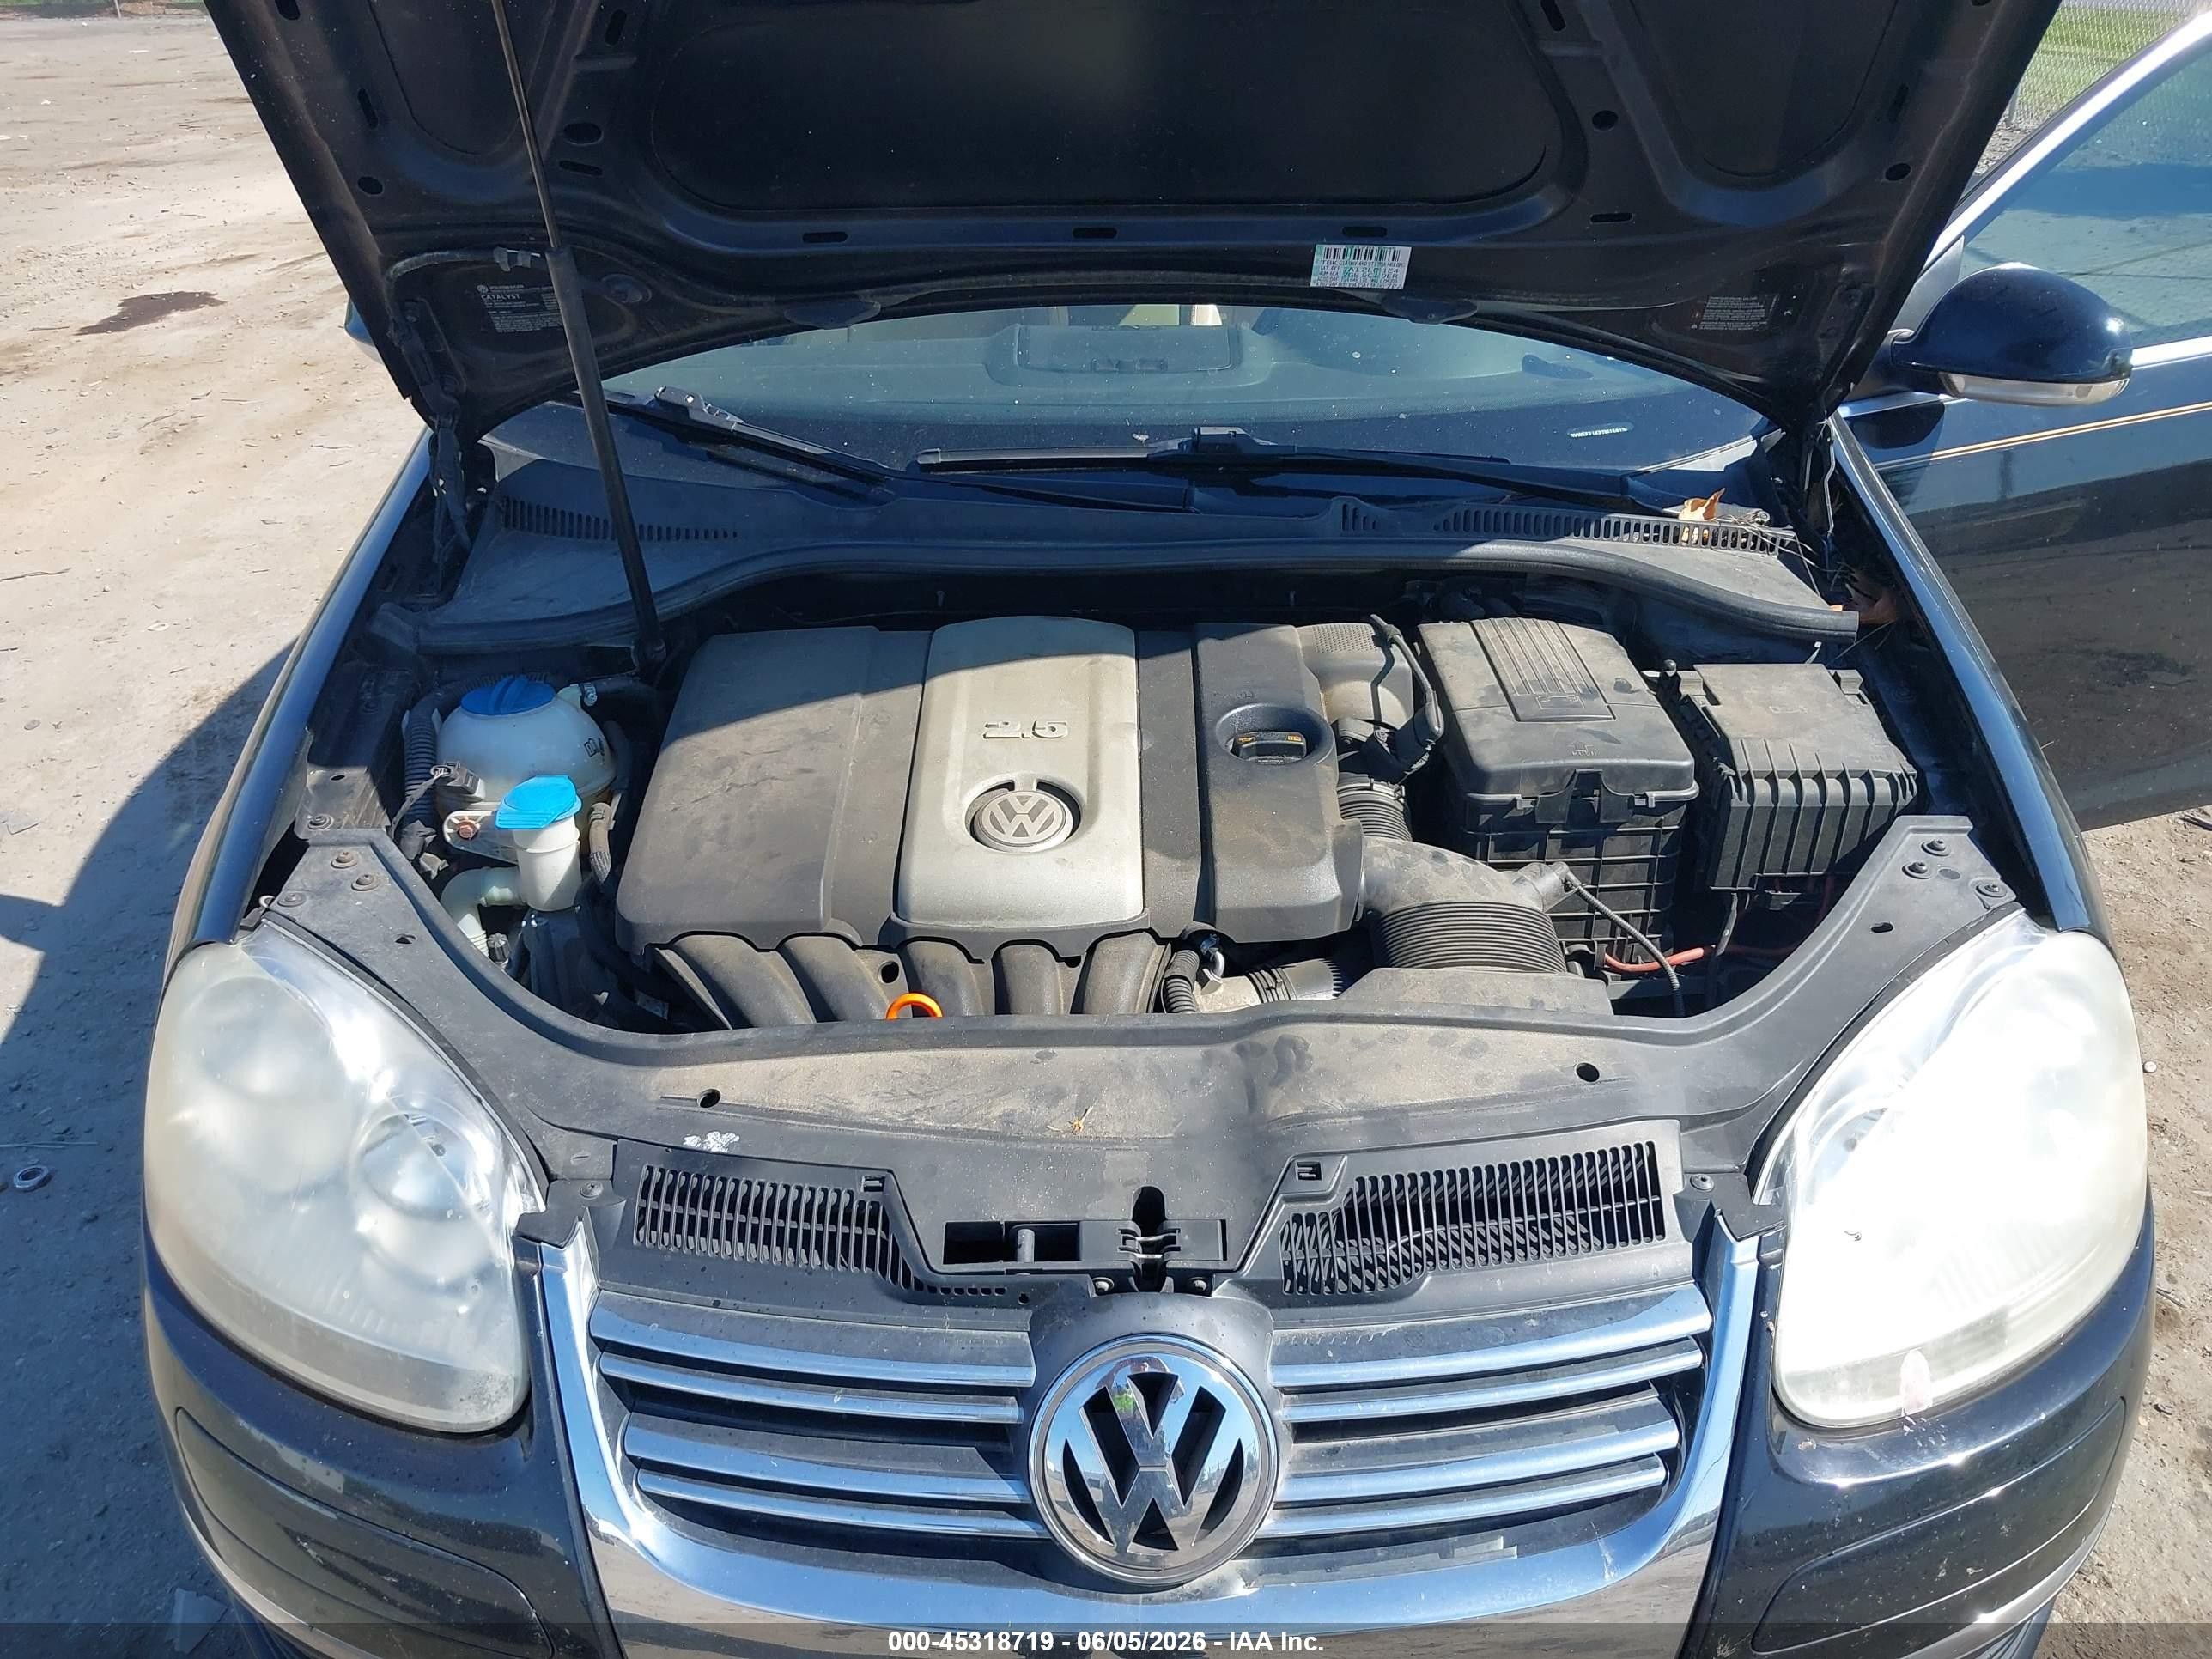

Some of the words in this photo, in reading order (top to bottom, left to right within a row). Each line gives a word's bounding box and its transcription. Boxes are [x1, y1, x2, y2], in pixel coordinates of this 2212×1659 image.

[983, 719, 1067, 740] 2.5
[981, 791, 1064, 845] VW
[1044, 1351, 1261, 1570] VW
